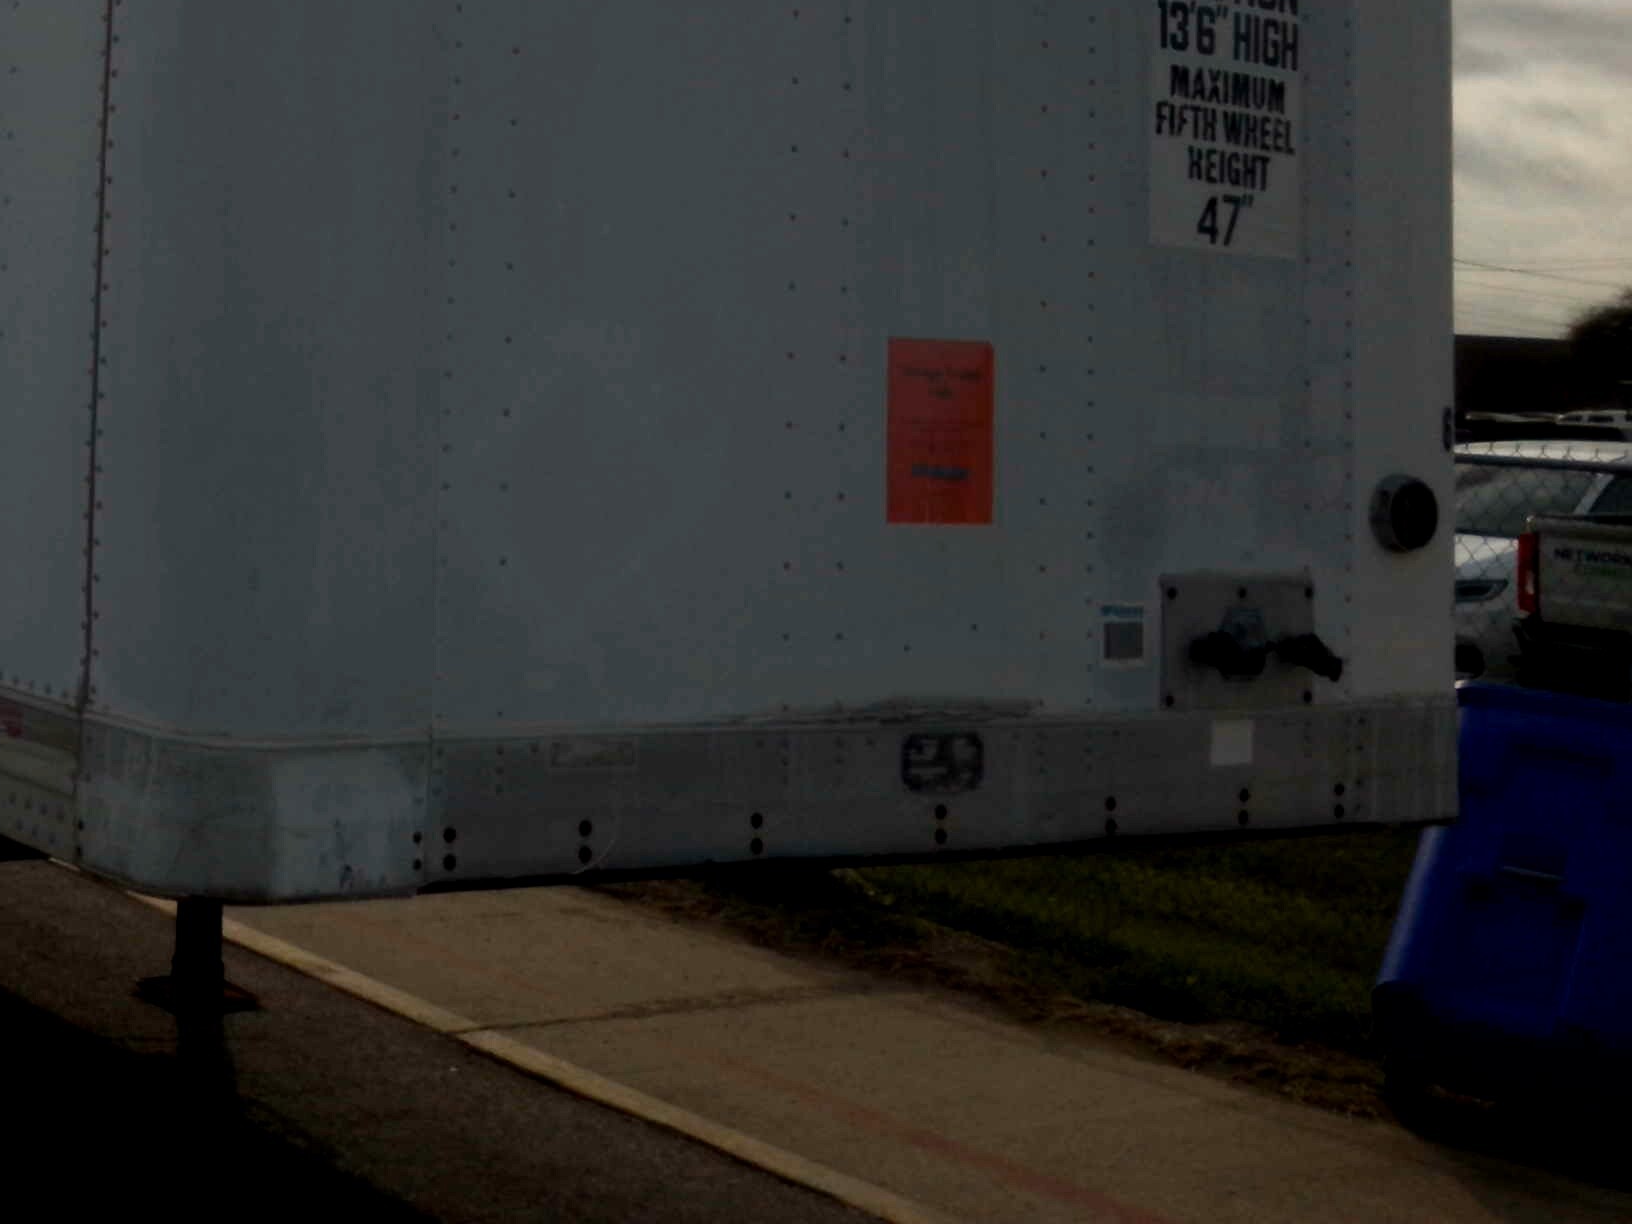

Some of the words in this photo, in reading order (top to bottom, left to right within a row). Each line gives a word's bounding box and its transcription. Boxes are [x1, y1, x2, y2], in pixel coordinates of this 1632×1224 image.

[1233, 11, 1299, 72] HIGH
[1170, 64, 1285, 115] MAXIMUM
[1155, 100, 1217, 142] FIFTH
[1222, 109, 1295, 156] WHEEL
[1187, 145, 1271, 192] HEIGHT
